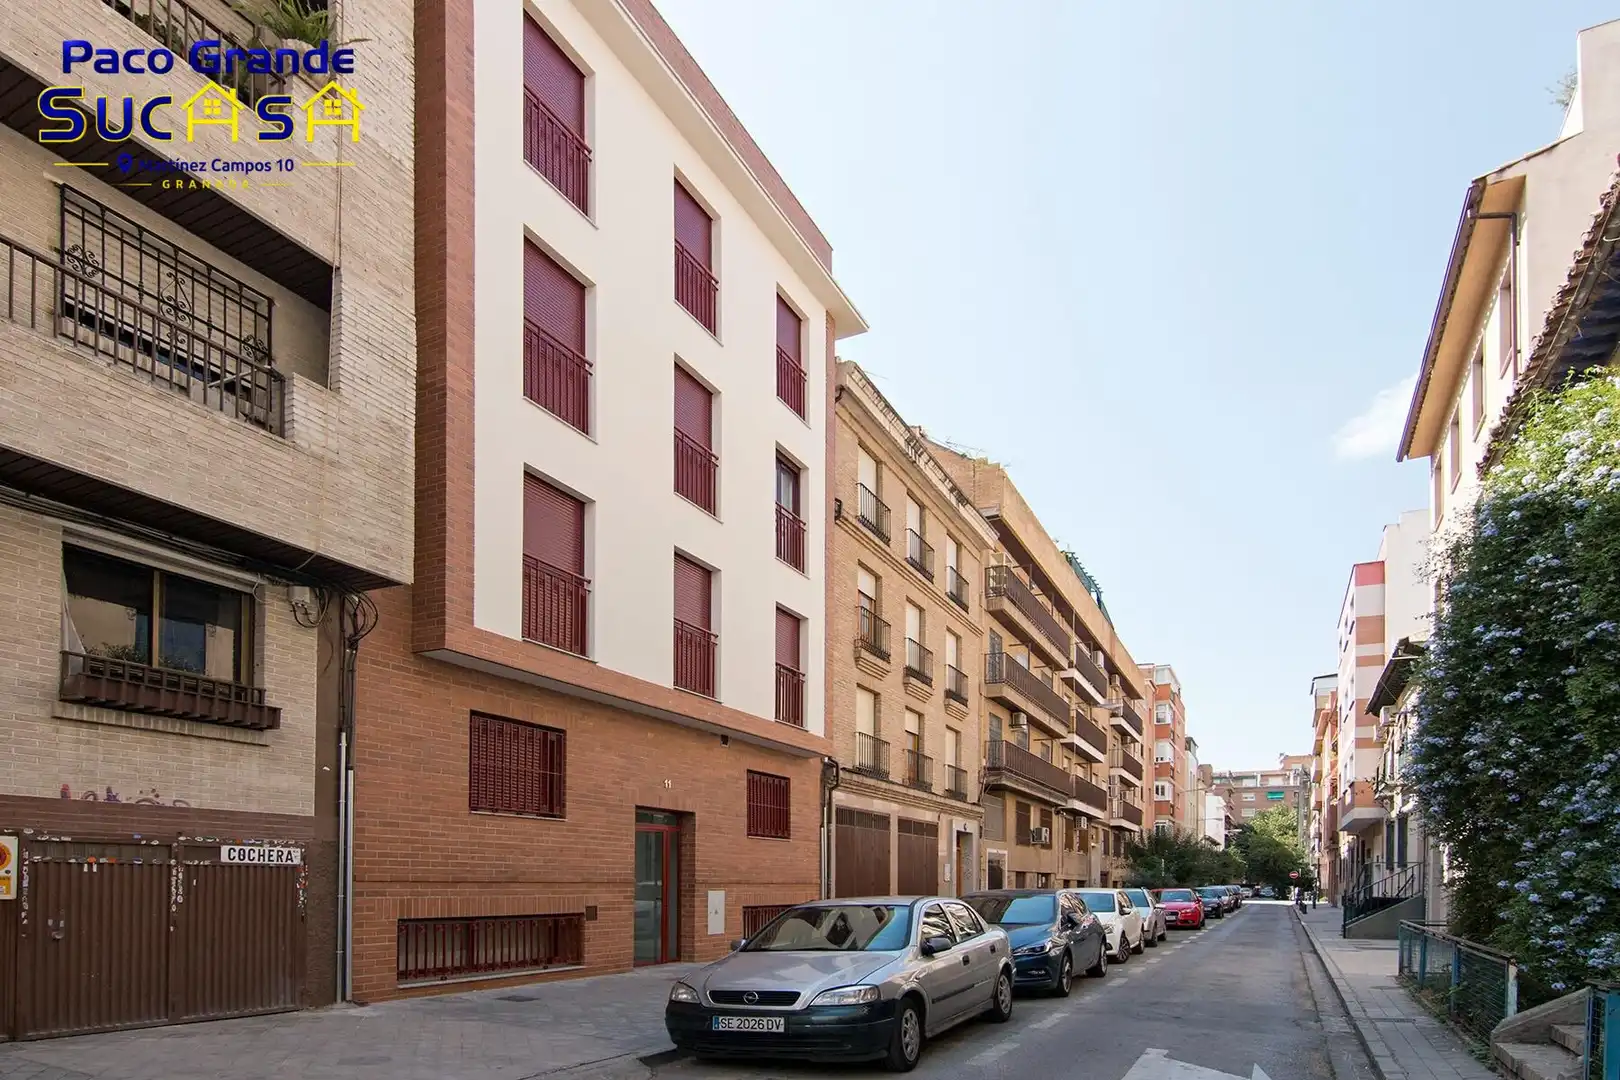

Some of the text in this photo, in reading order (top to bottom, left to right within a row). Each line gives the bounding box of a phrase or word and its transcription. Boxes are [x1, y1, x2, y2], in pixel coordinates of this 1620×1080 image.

[664, 779, 672, 789] 11
[227, 847, 294, 863] COCHERA
[720, 1018, 781, 1031] SE 2026 DV
